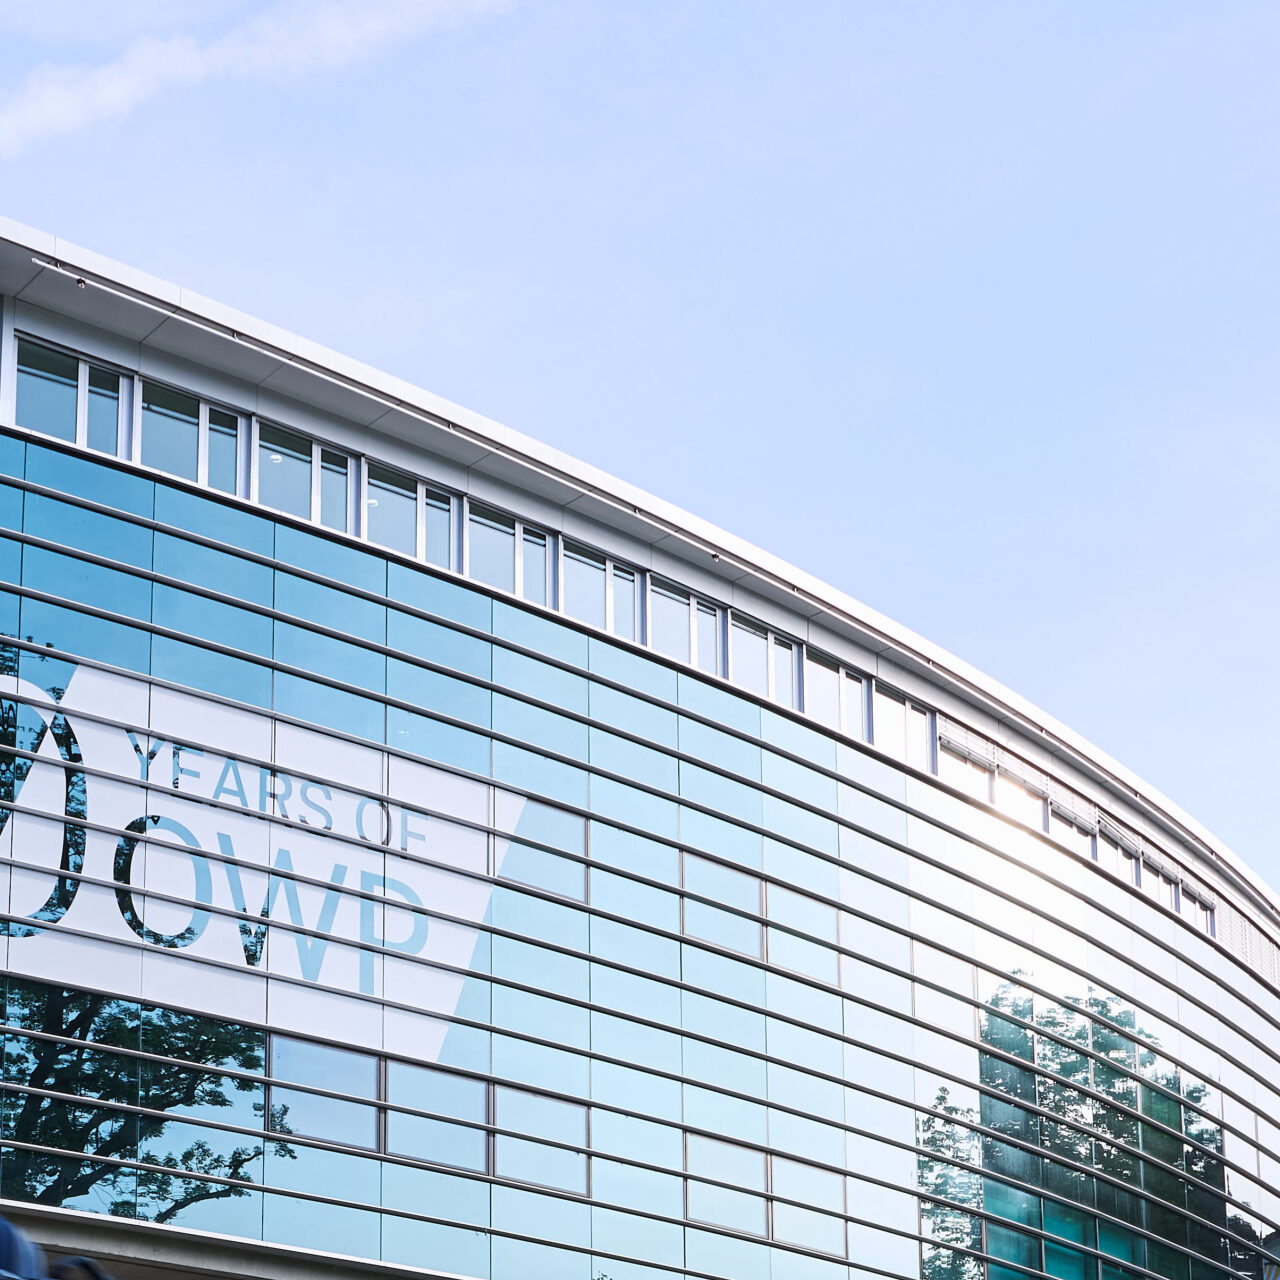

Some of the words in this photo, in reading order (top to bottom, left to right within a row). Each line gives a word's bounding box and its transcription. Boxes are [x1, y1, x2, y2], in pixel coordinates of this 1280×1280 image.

[125, 728, 334, 836] YEARS
[355, 797, 429, 853] OF
[113, 815, 429, 996] OWP
